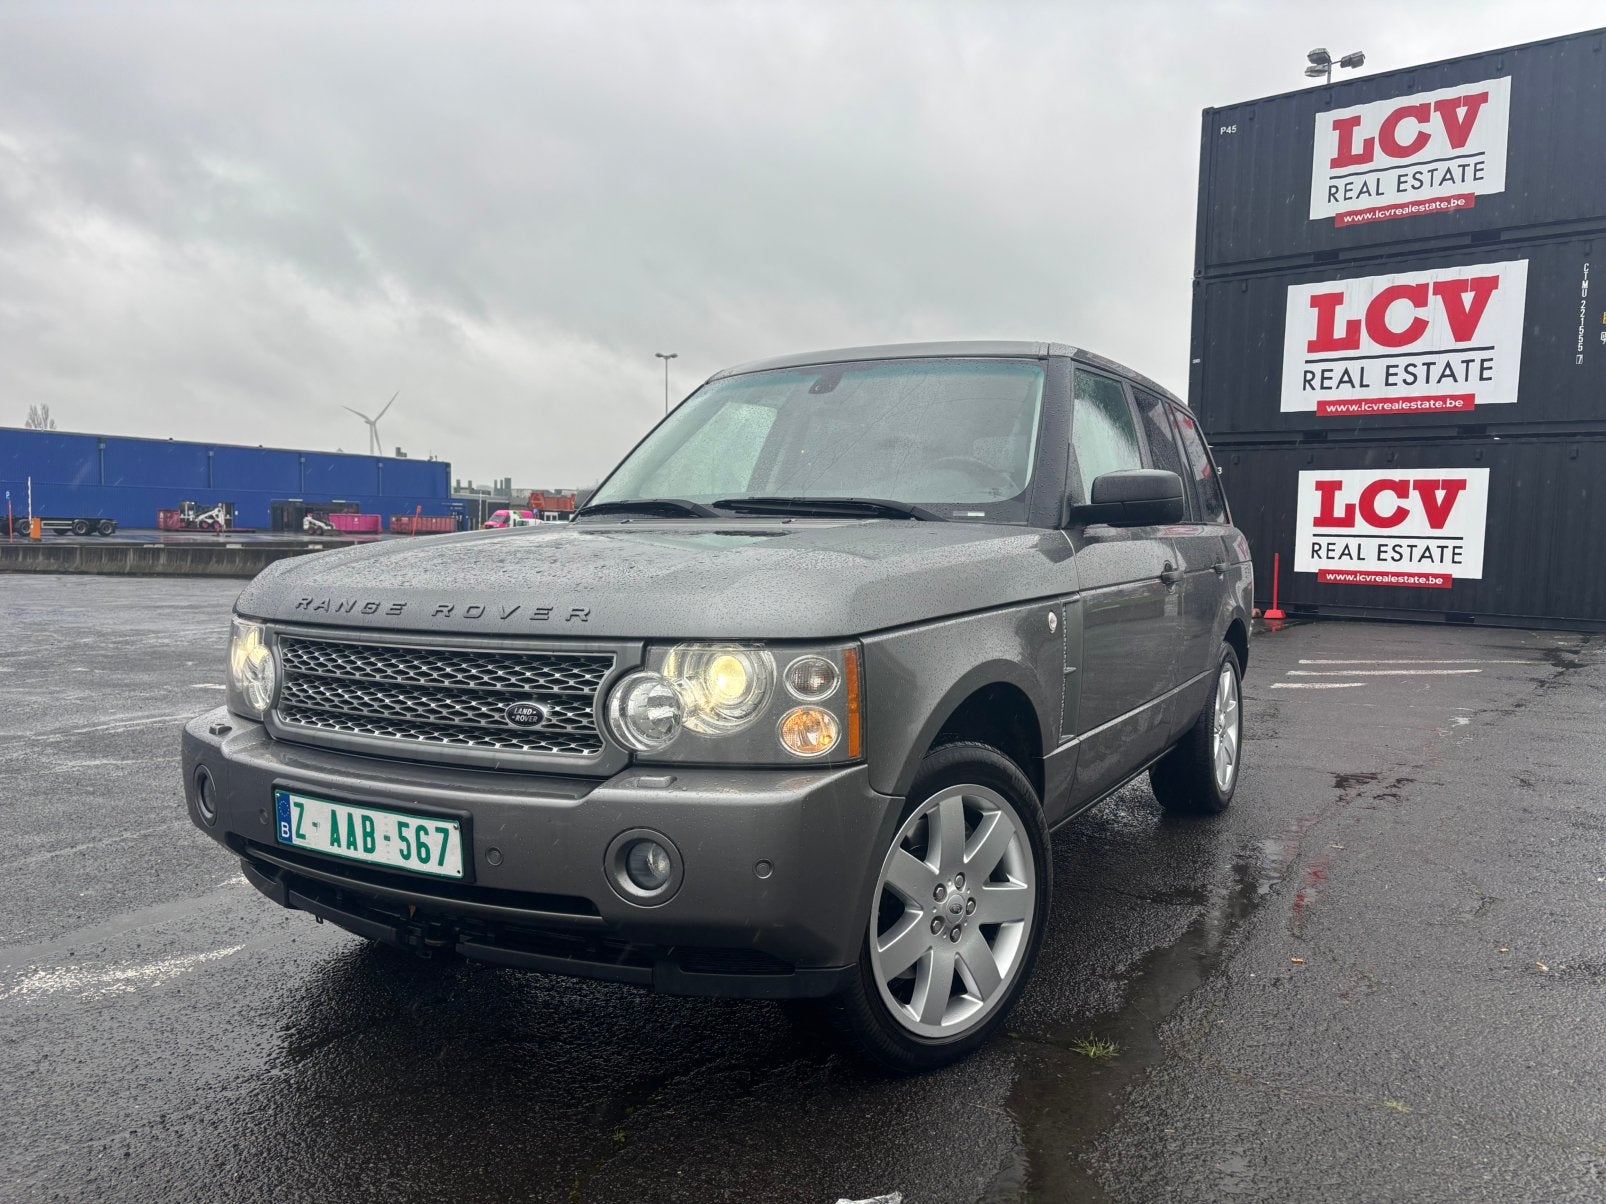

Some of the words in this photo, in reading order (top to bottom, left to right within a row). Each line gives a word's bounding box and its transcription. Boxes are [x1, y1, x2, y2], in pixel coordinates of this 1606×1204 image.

[1220, 124, 1237, 135] P45
[1329, 91, 1489, 169] LCV
[1327, 177, 1385, 204] REAL
[1396, 160, 1485, 193] ESTATE
[1343, 196, 1466, 223] www.lcvrealestate.be
[1306, 274, 1500, 354] LCV
[1302, 366, 1370, 391] REAL
[1384, 357, 1494, 387] ESTATE
[1325, 398, 1464, 413] www.lcvrealestate.be
[1312, 478, 1468, 530] LCV
[1311, 542, 1366, 561] REAL
[1376, 543, 1464, 565] ESTATE
[1326, 571, 1444, 585] www.lcvrealestate.be
[295, 597, 408, 616] RANGE
[431, 603, 592, 622] ROVER
[280, 821, 291, 838] B
